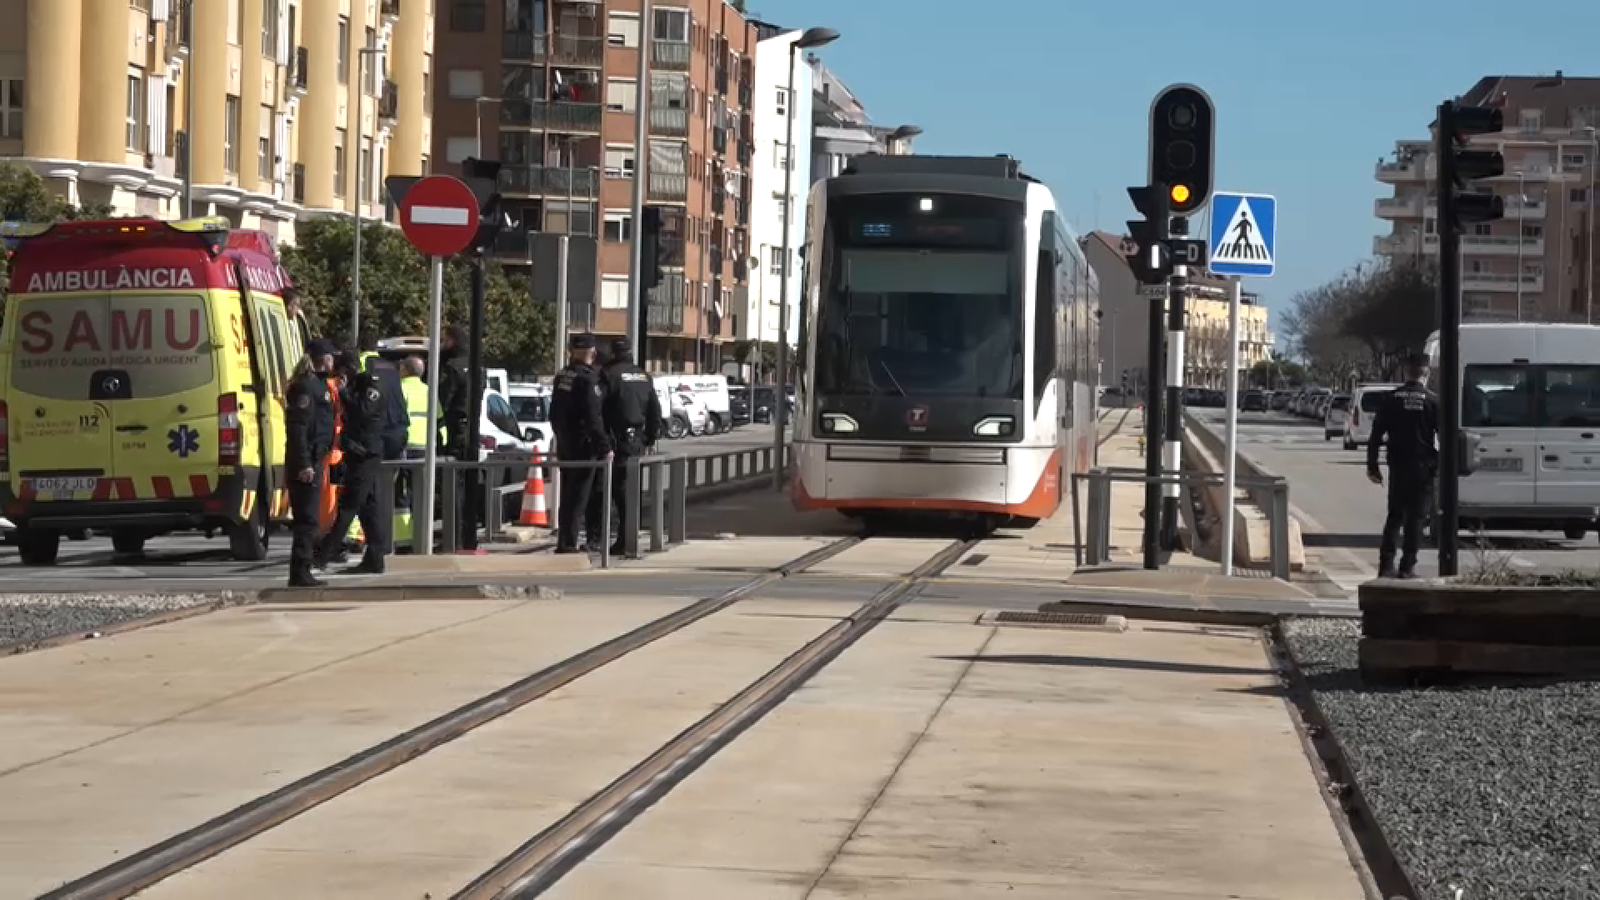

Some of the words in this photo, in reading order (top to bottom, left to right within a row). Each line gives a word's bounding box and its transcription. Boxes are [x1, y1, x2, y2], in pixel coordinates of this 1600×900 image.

[28, 265, 194, 291] AMBULÀNCIA
[21, 308, 199, 353] SAMU
[155, 355, 198, 366] URGENT
[79, 414, 99, 428] 112
